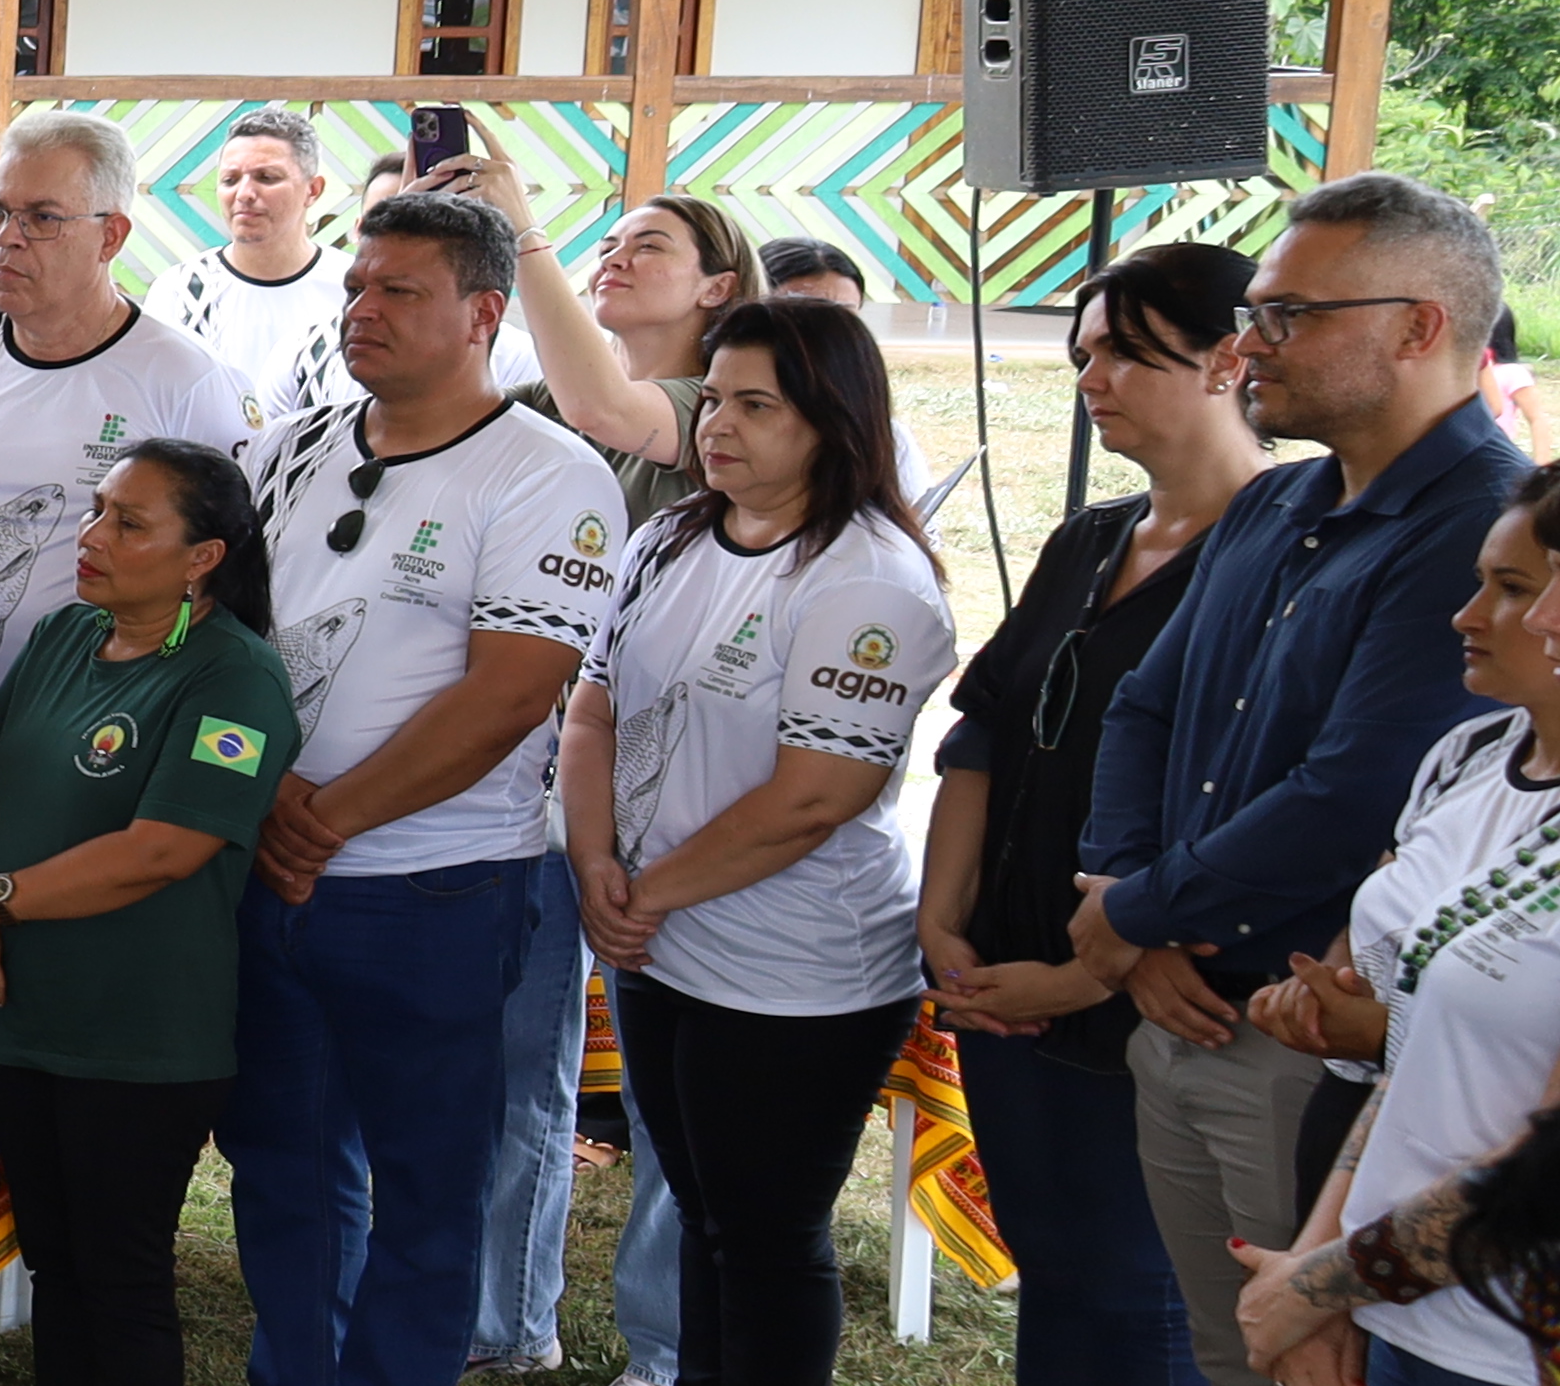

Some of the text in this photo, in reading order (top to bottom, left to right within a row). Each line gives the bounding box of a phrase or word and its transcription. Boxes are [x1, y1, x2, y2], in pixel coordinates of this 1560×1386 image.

[391, 552, 446, 572] INSTITUTO
[538, 554, 614, 597] agpn
[810, 666, 908, 706] agpn
